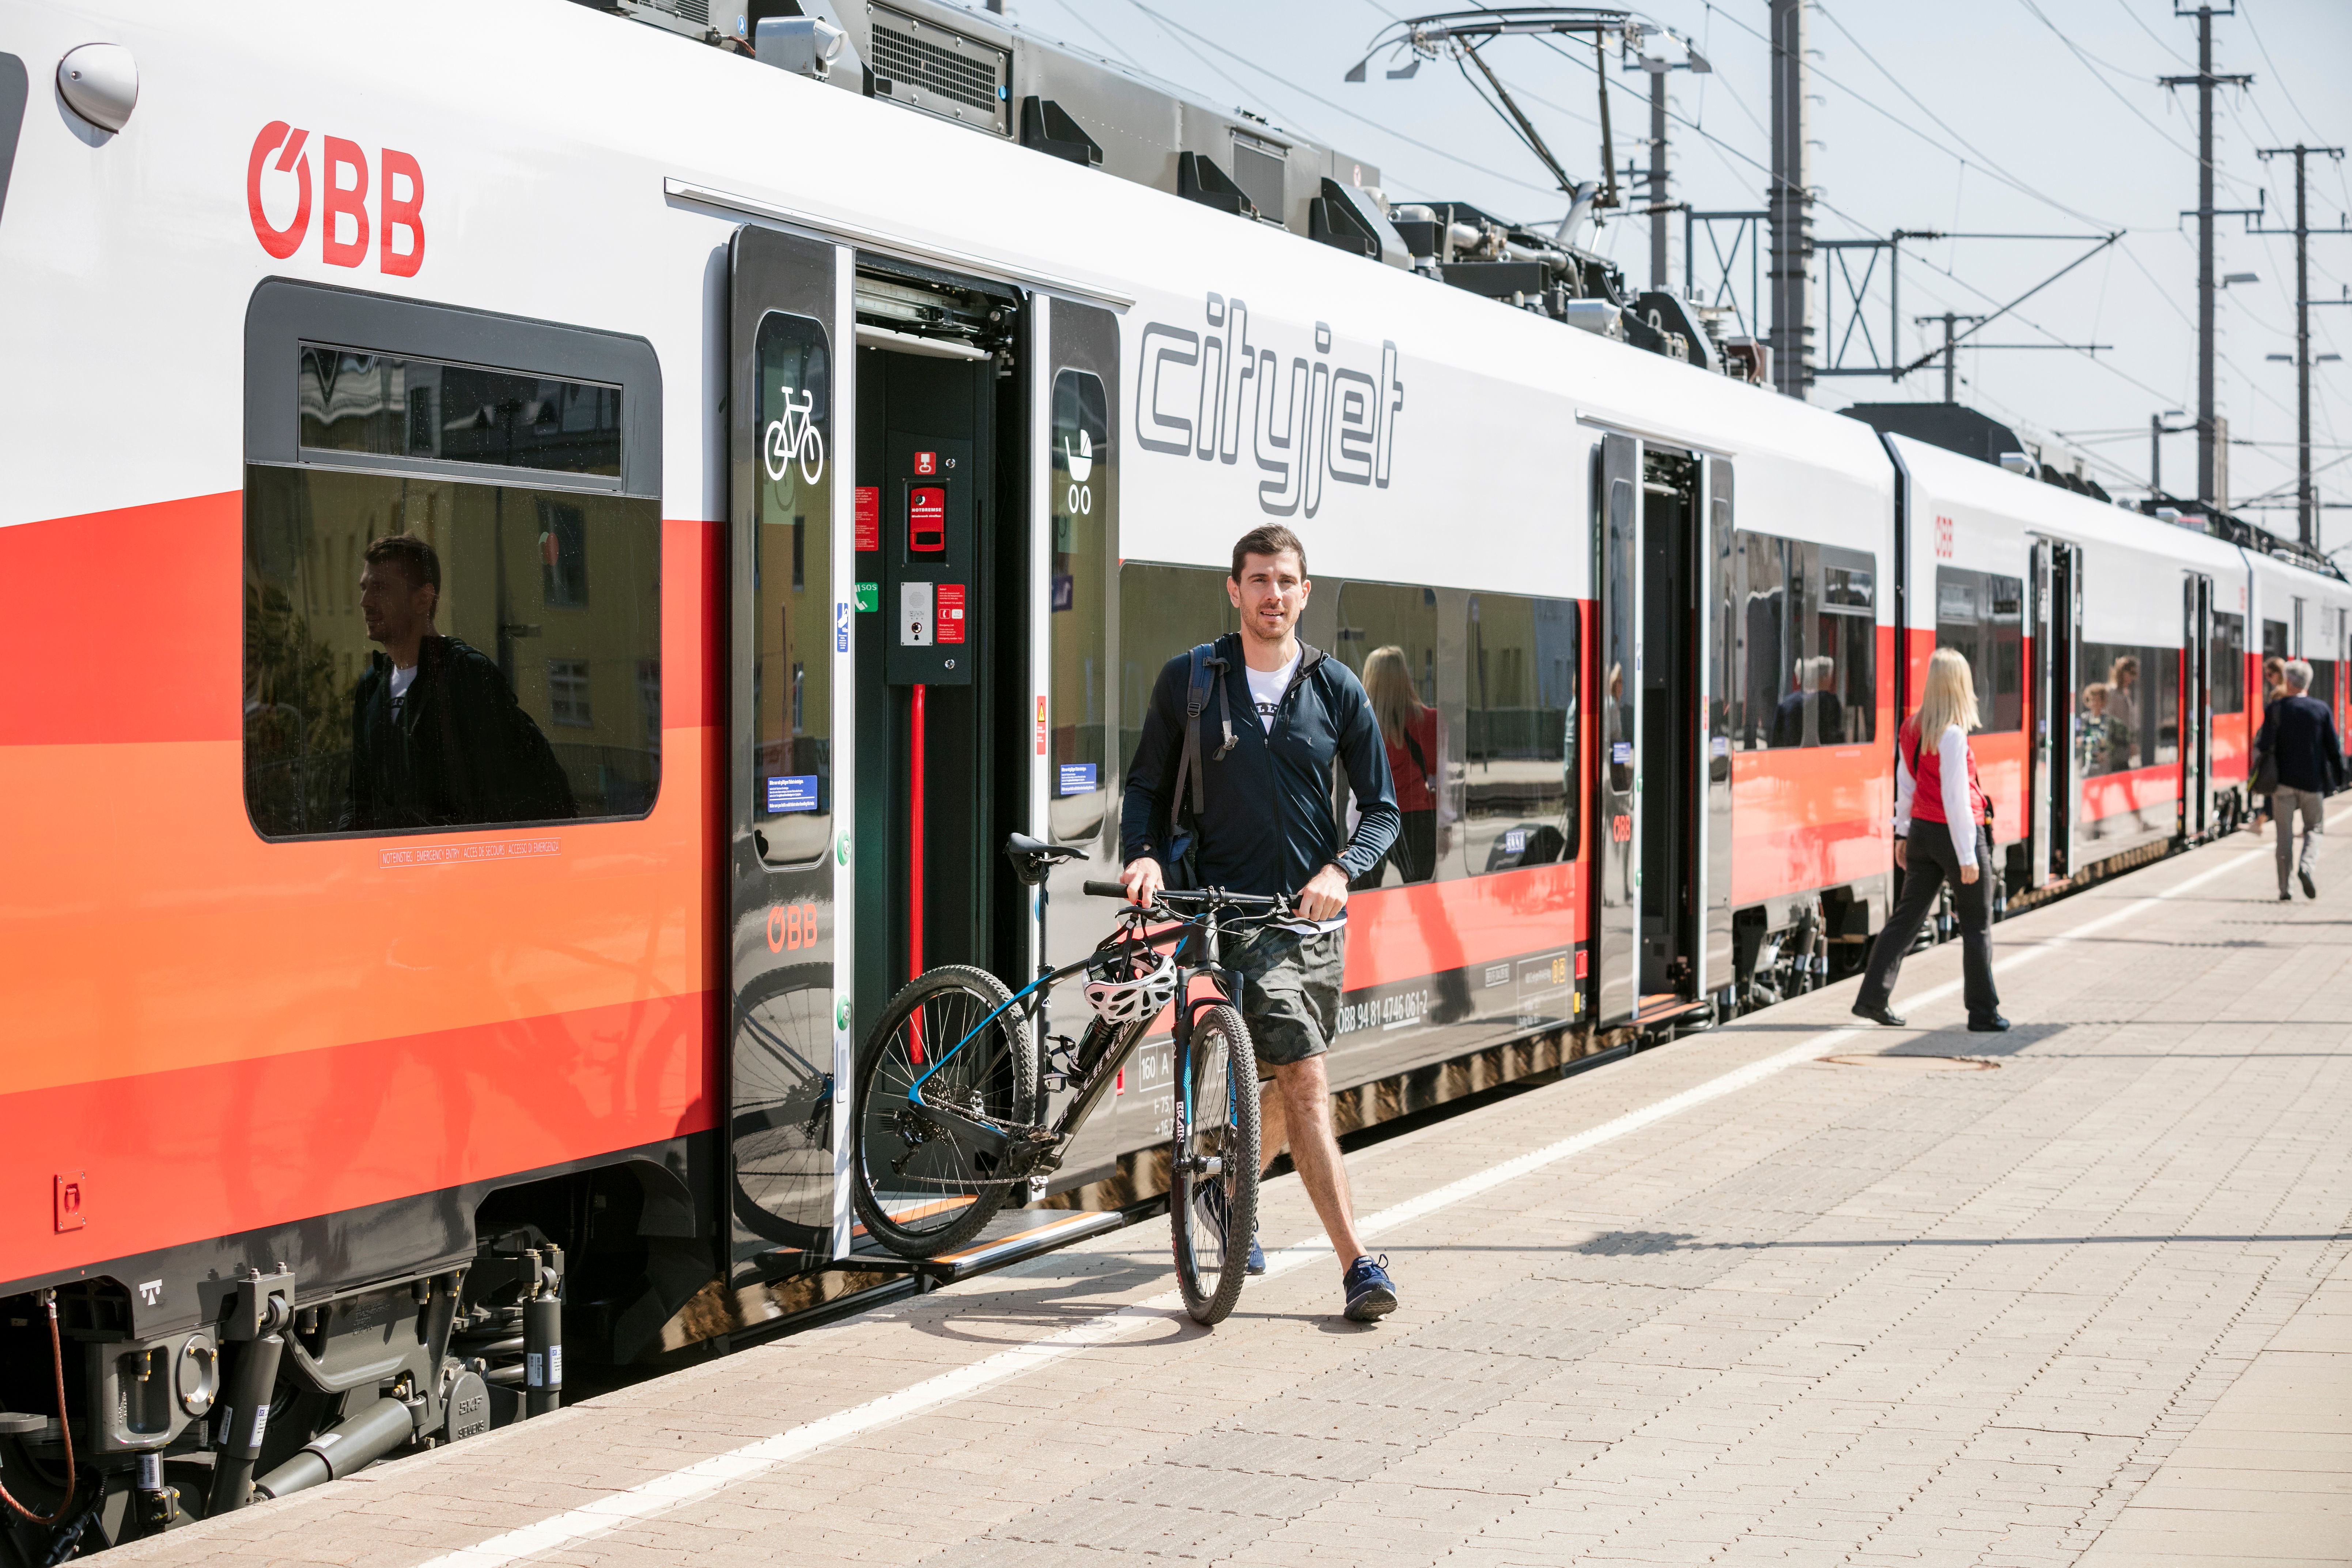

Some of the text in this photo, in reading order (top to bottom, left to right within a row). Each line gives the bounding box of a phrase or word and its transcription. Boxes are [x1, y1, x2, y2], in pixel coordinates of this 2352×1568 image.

[247, 121, 425, 277] ÖBB
[1136, 292, 1403, 519] cityjet
[1613, 815, 1631, 842] ÖBB
[383, 842, 559, 864] NOTEINSTIEG / EMERGENCY ENTRY / ACCES DE SECOURS / ACCESSO DI EMERGENZA
[767, 903, 817, 953] ÖBB
[1337, 989, 1428, 1034] ÖBB 94 81 4746 061-2
[1141, 1053, 1169, 1080] 160 A
[459, 1395, 483, 1416] SKF
[458, 1420, 484, 1439] SIEMENS
